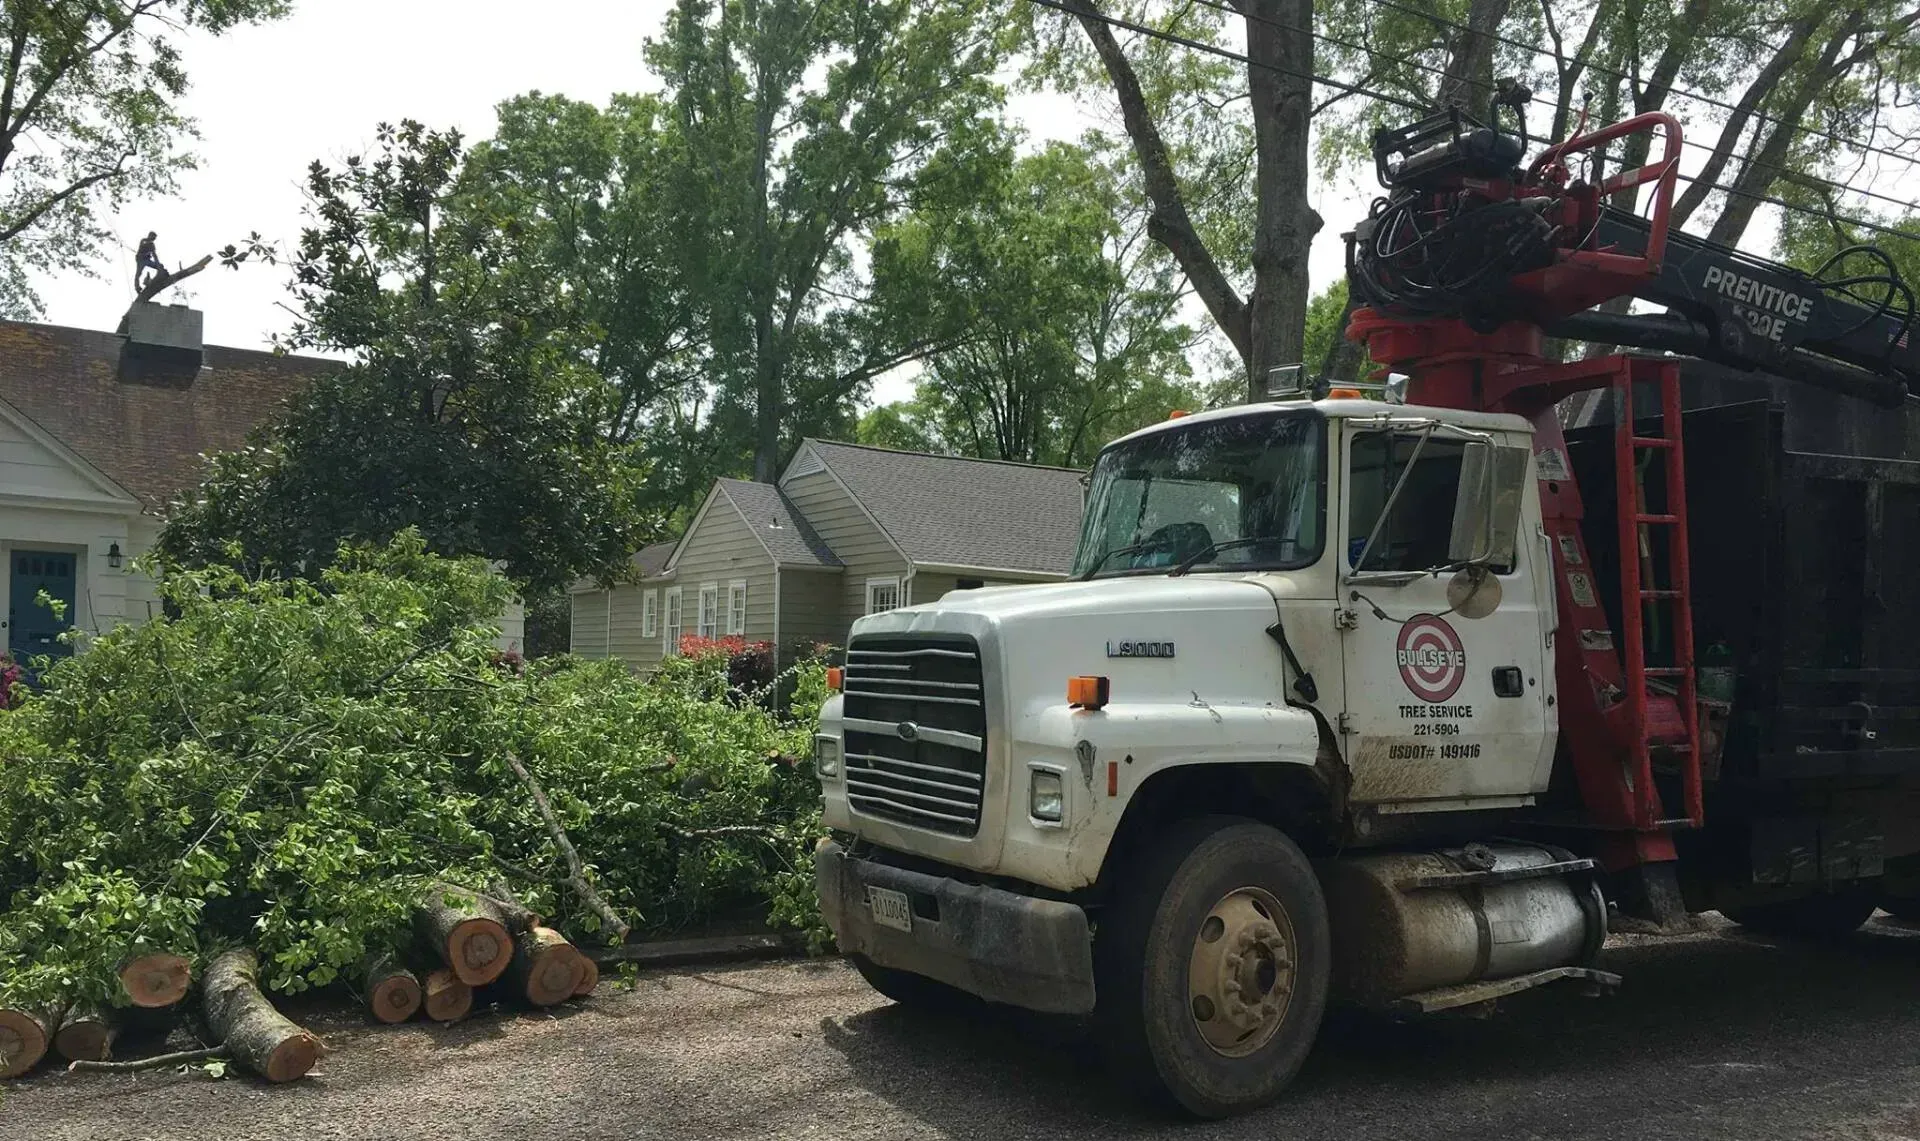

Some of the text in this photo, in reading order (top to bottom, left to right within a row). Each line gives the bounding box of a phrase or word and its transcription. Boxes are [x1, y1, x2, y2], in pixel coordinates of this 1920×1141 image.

[1702, 265, 1814, 322] PRENTICE
[1398, 649, 1465, 668] BULLSEYE
[1399, 705, 1473, 719] TREE SERVICE
[1413, 723, 1460, 736] 221-5904
[1388, 744, 1481, 760] USDOT# 1491416
